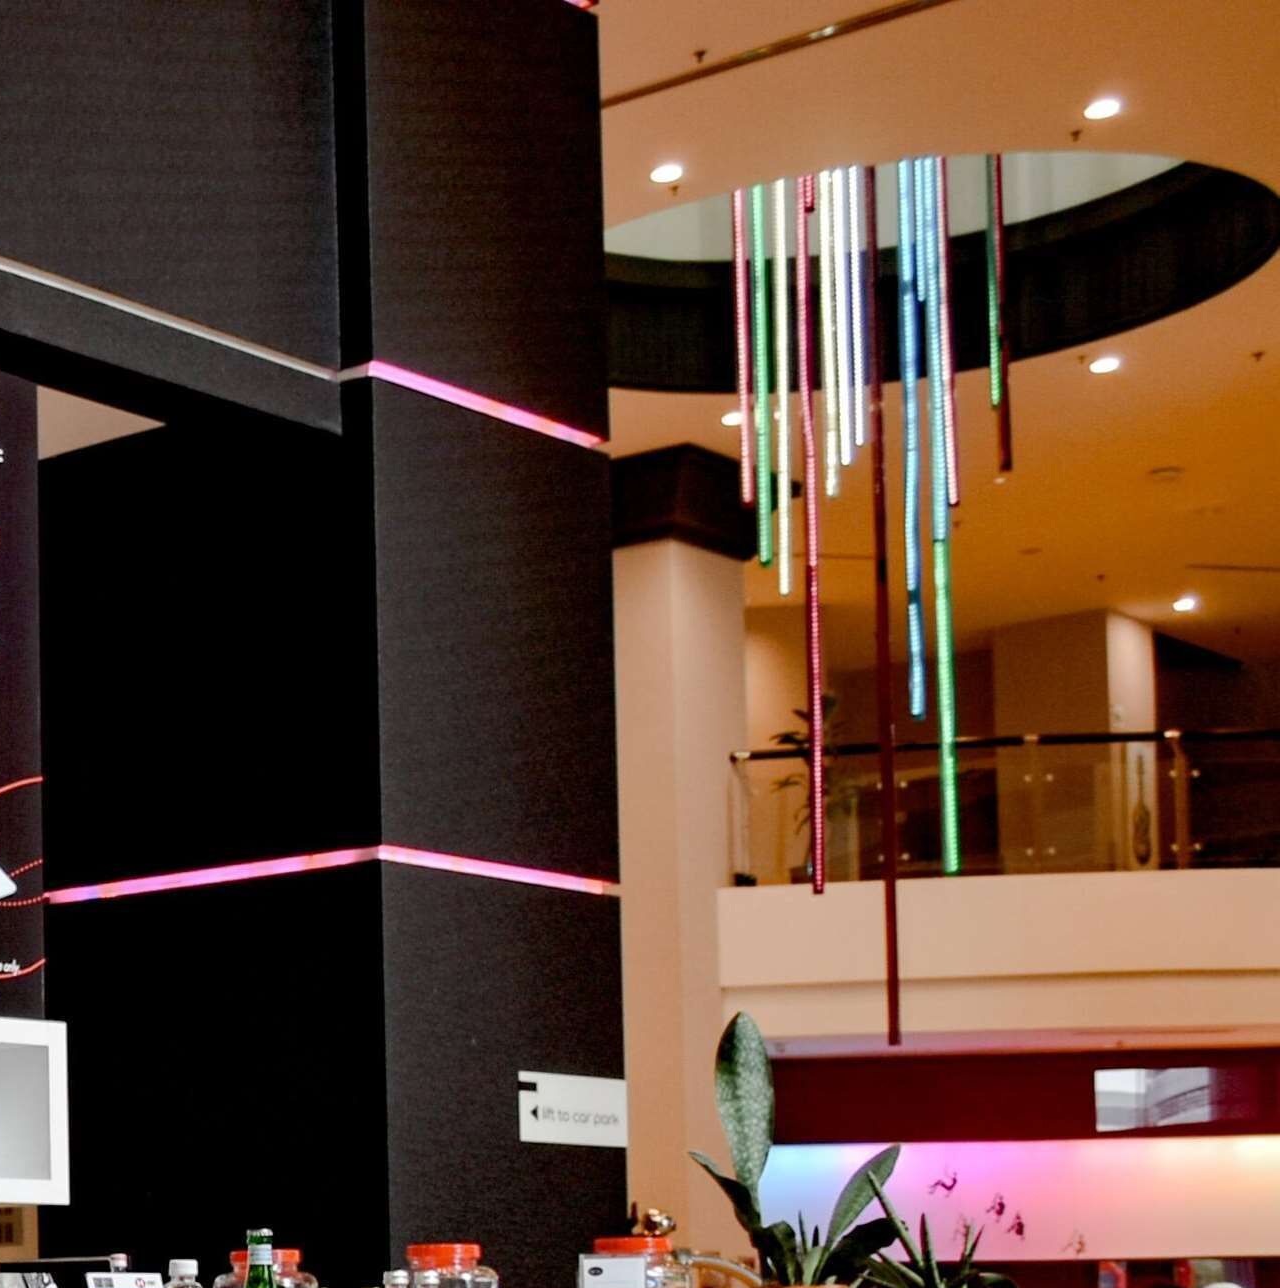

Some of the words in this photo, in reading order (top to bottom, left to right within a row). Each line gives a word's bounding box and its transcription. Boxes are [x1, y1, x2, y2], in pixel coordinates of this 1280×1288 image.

[557, 1110, 570, 1122] to
[573, 1112, 591, 1123] car
[593, 1112, 619, 1126] park
